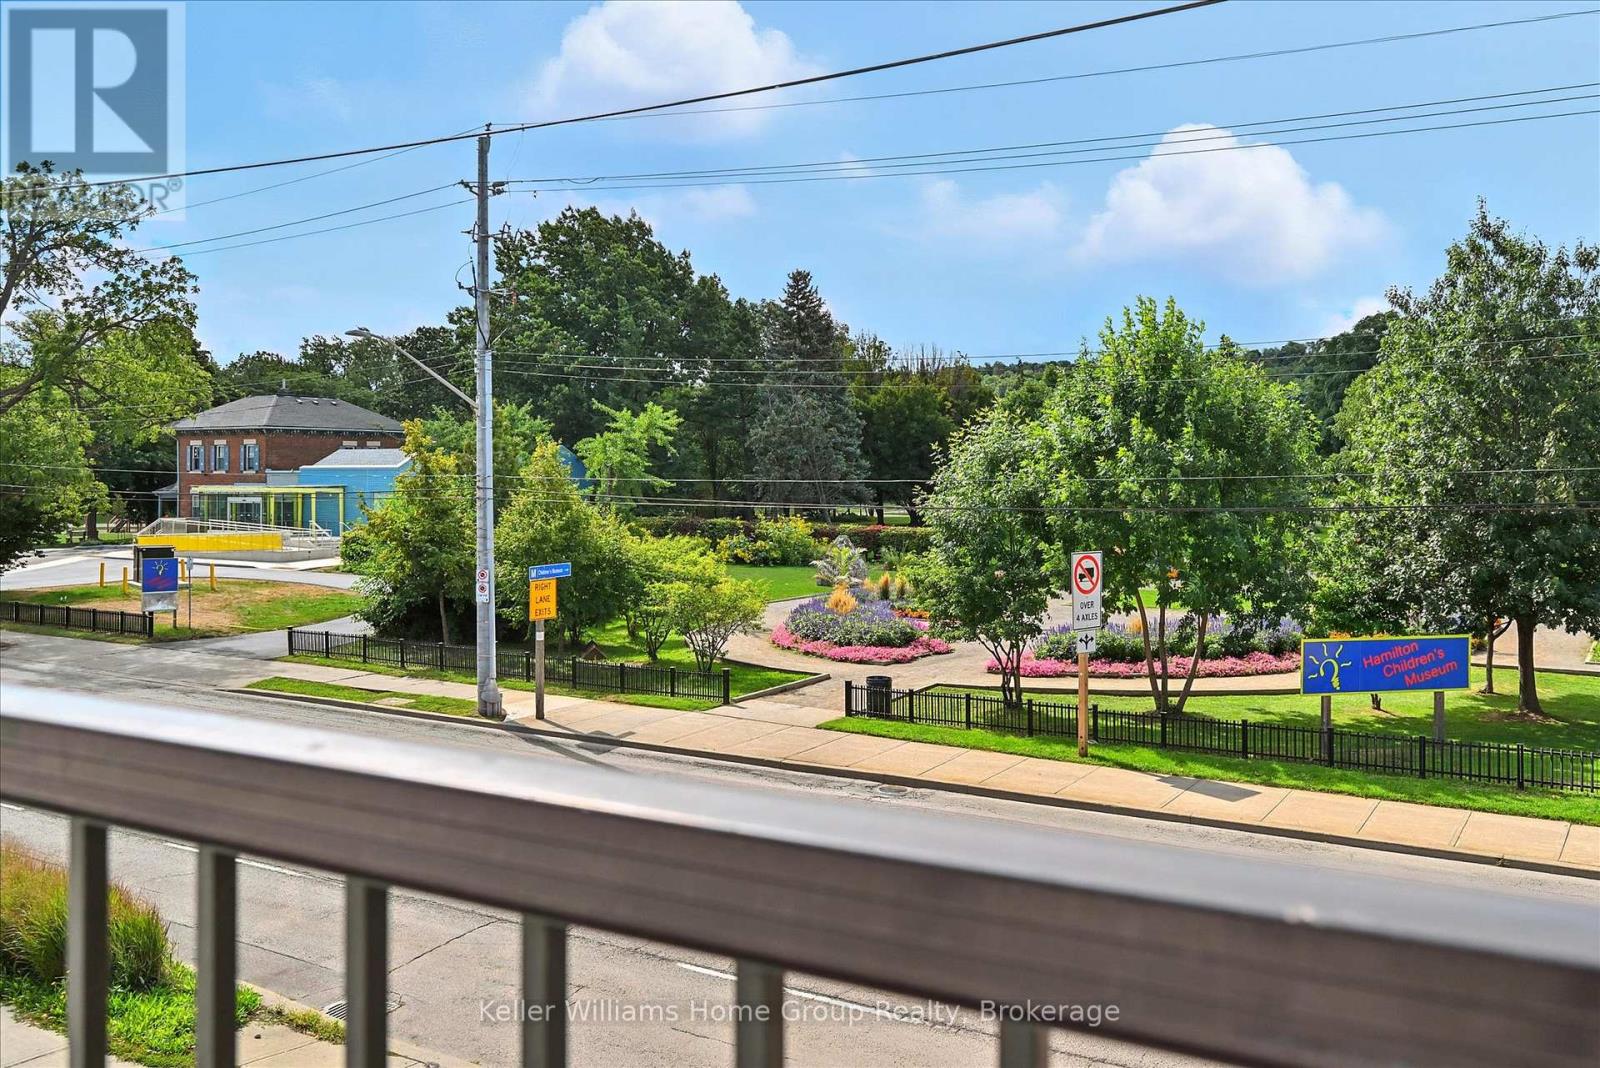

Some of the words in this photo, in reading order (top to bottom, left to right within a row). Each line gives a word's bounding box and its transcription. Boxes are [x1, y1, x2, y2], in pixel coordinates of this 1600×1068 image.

[535, 583, 551, 591] RIGHT
[536, 595, 551, 604] LANE
[1080, 601, 1095, 609] OVER
[535, 608, 551, 616] EXITS
[1081, 613, 1098, 621] AXLES
[1363, 641, 1419, 668] Hamilton
[1382, 648, 1446, 678] Children's
[1404, 660, 1458, 687] Museum
